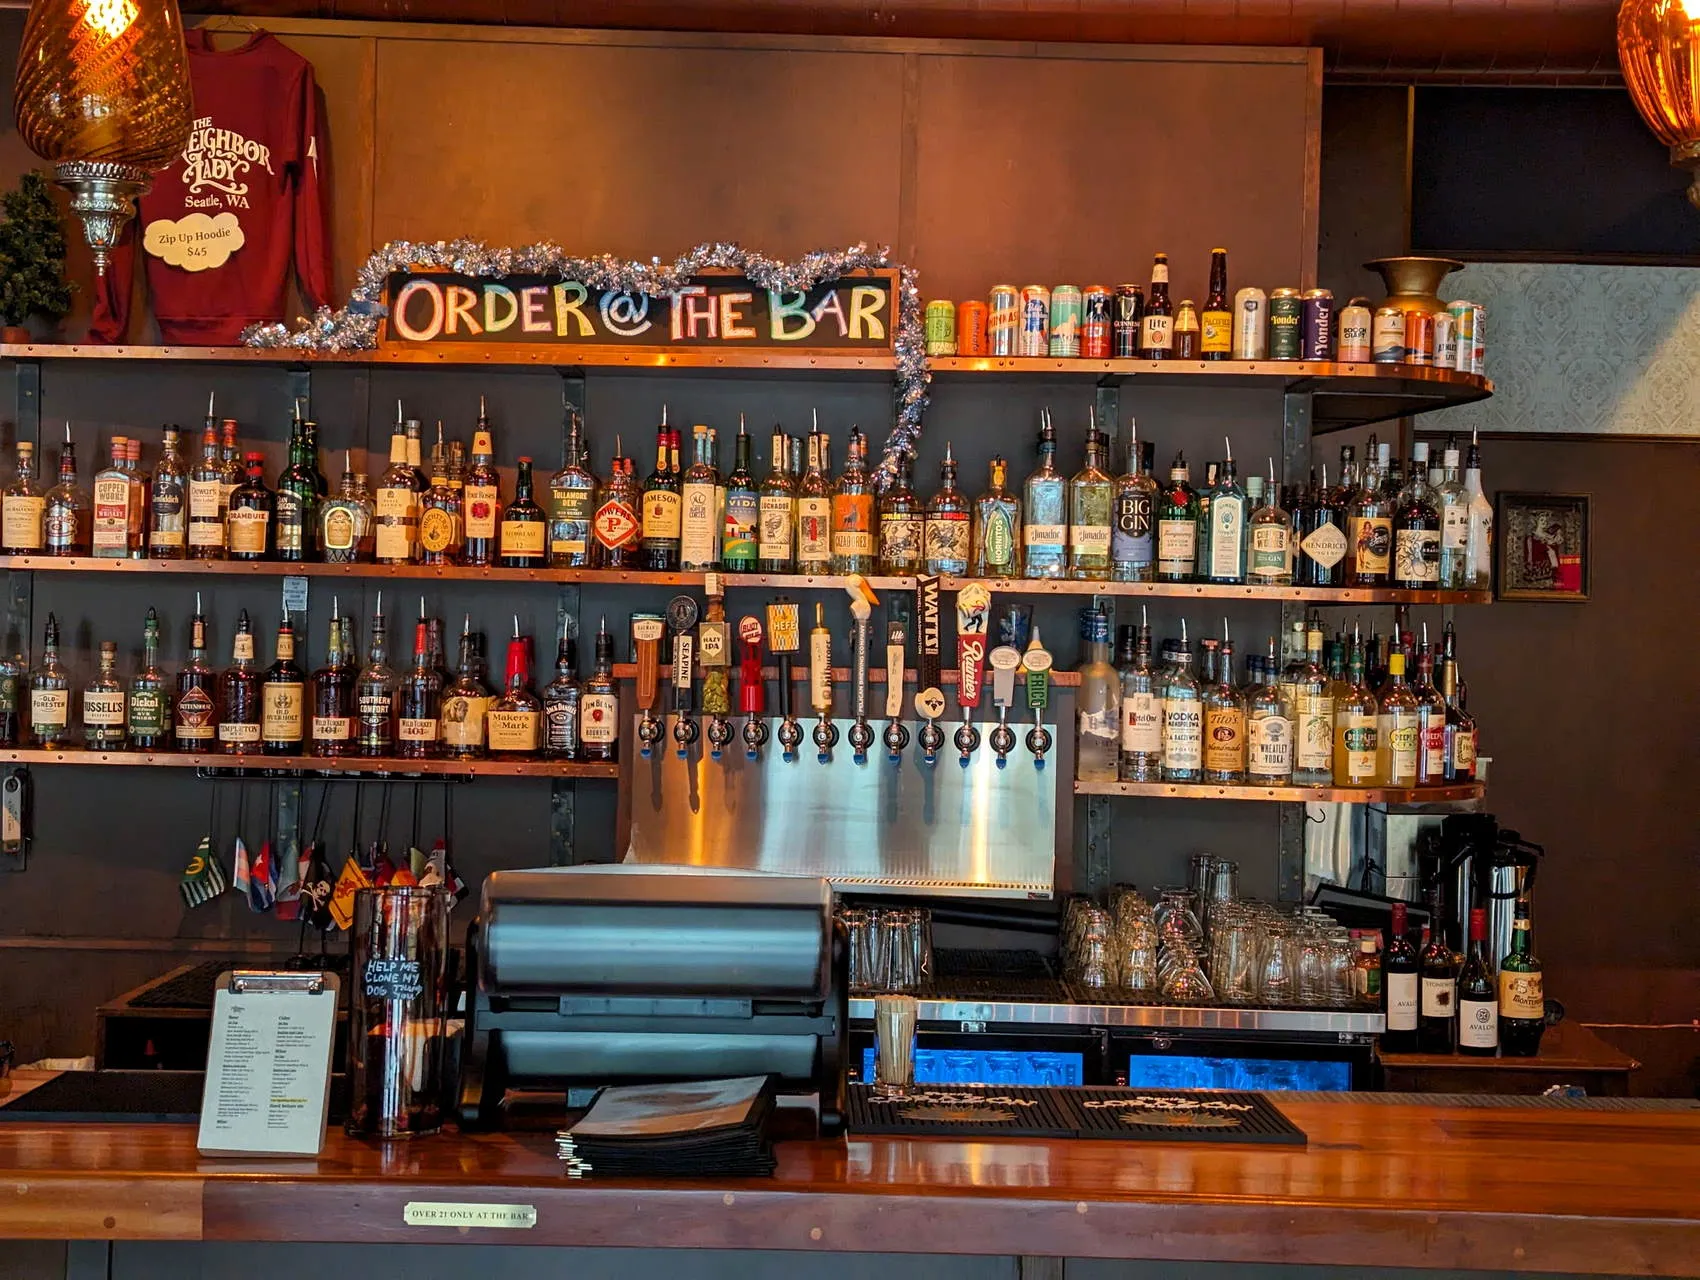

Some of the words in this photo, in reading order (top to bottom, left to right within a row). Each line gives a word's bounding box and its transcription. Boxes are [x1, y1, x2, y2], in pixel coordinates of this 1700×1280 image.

[193, 117, 213, 130] THE
[182, 128, 275, 176] EIGHBOR
[182, 152, 251, 194] LADY
[226, 195, 250, 209] WA
[159, 234, 176, 245] Zip
[178, 233, 193, 244] Up
[195, 228, 231, 241] Hoodie
[187, 247, 208, 257] $45
[394, 279, 596, 341] ORDER
[600, 291, 652, 337] @
[669, 286, 757, 340] THE
[770, 286, 887, 340] BAR
[1149, 319, 1167, 331] Lite
[1271, 315, 1300, 325] Yonder
[1314, 301, 1329, 356] Yonder
[98, 483, 125, 493] COPPER
[99, 493, 124, 501] WORKS
[553, 489, 588, 500] TULLAMORE
[643, 494, 678, 505] JAMESON
[1122, 500, 1150, 515] BIG
[229, 512, 266, 520] DRAMBUIE
[606, 517, 621, 533] P
[1120, 515, 1149, 530] GIN
[995, 519, 1003, 562] HORNITOS
[924, 581, 939, 649] WATTS
[773, 621, 796, 631] HEFE
[859, 624, 867, 655] COMPANY
[680, 642, 690, 681] SEAPINE
[961, 640, 984, 700] Rainier
[33, 700, 65, 708] FORESTER
[130, 696, 159, 707] Dickel
[359, 696, 391, 705] SOUTHERN
[857, 685, 865, 713] PELICAN
[360, 704, 389, 714] COMFORT
[546, 704, 558, 715] JACK
[584, 700, 595, 712] JIM
[492, 713, 529, 721] Maker's
[1129, 712, 1146, 726] Ketel
[1167, 712, 1200, 721] VODKA
[1210, 713, 1238, 724] Tito's
[502, 721, 529, 729] Mark
[96, 729, 104, 740] 6
[407, 727, 424, 735] 101
[1260, 744, 1288, 753] WHEATLEY
[1264, 754, 1284, 763] VODKA
[367, 960, 397, 972] HELP
[400, 961, 420, 973] ME
[365, 972, 399, 983] CLONE
[402, 973, 420, 985] MY
[366, 985, 388, 996] DOG
[412, 1210, 437, 1218] OVER
[450, 1211, 474, 1219] ONLY
[510, 1212, 529, 1220] BAR
